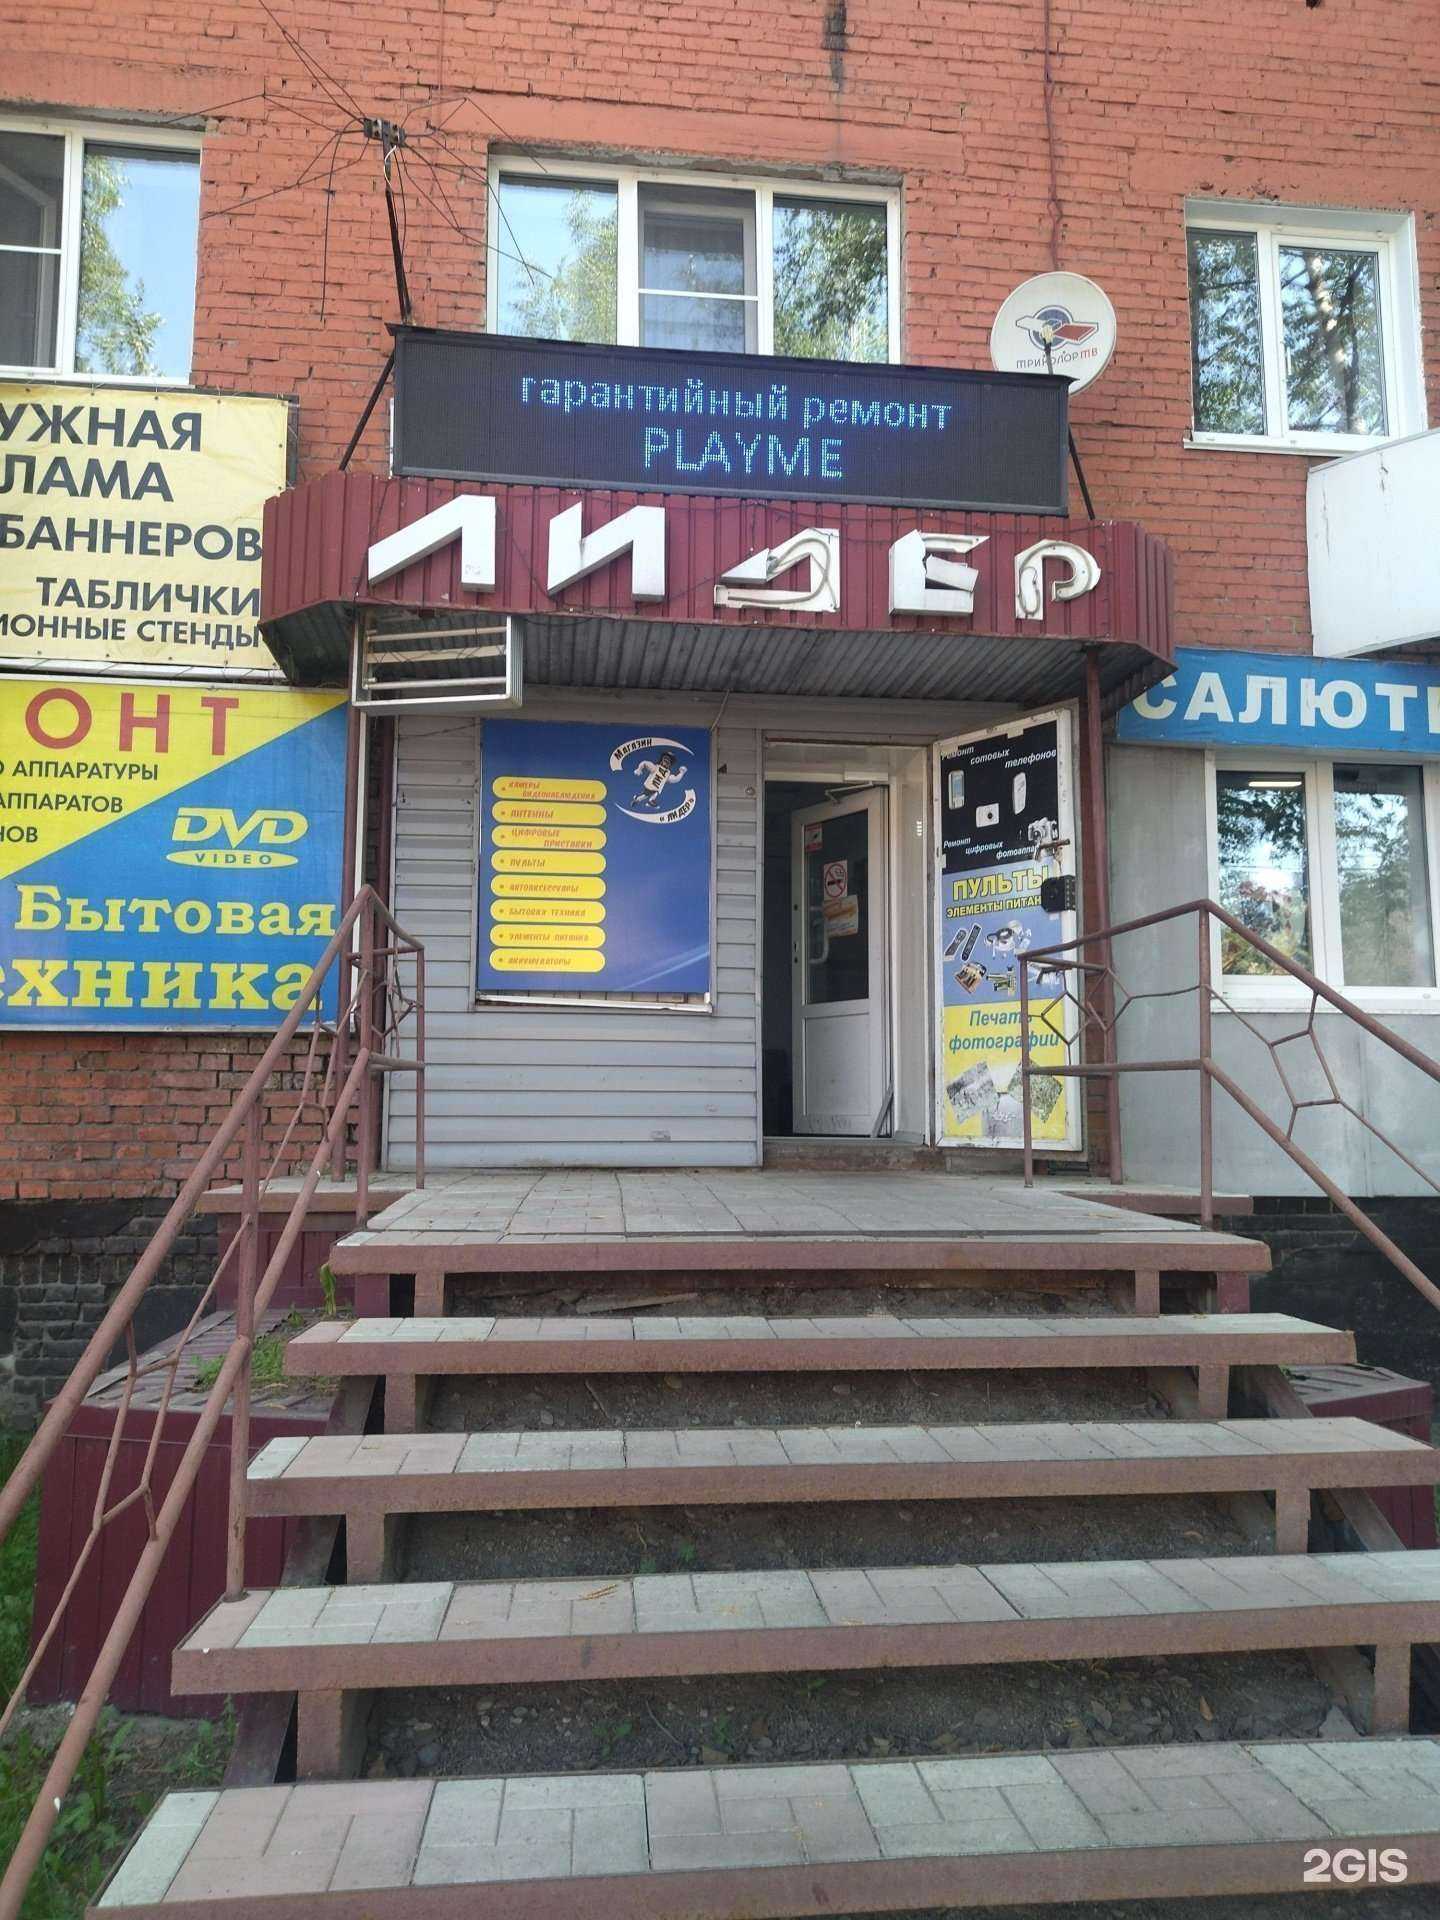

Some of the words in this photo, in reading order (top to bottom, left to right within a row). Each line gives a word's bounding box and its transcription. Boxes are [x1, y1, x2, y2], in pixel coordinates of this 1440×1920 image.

[522, 376, 789, 421] гарантийный
[803, 394, 952, 430] ремонт
[0, 402, 202, 452] УЖНАЯ
[643, 426, 844, 479] PLAYME
[0, 453, 174, 502] ЛАМА
[0, 512, 263, 561] БАННЕРОВ
[367, 493, 1102, 621] ЛИДЕР
[36, 576, 260, 617] ТАБЛИЧКИ
[136, 620, 259, 650] СТЕНДЫ
[25, 687, 240, 756] ОНТ
[12, 760, 158, 781] АППАРАТУРЫ
[1004, 748, 1057, 769] телефонов
[172, 807, 309, 849] DVD
[943, 837, 971, 849] Ремонт
[195, 853, 272, 866] VIDEO
[952, 865, 1049, 901] ПУЛЬТЫ
[14, 884, 336, 936] Бытовая
[946, 900, 1003, 918] ЭЛЕМЕНТЫ
[1006, 895, 1042, 910] ПИТАН
[0, 958, 323, 1011] хника
[949, 1030, 1060, 1055] фотографии
